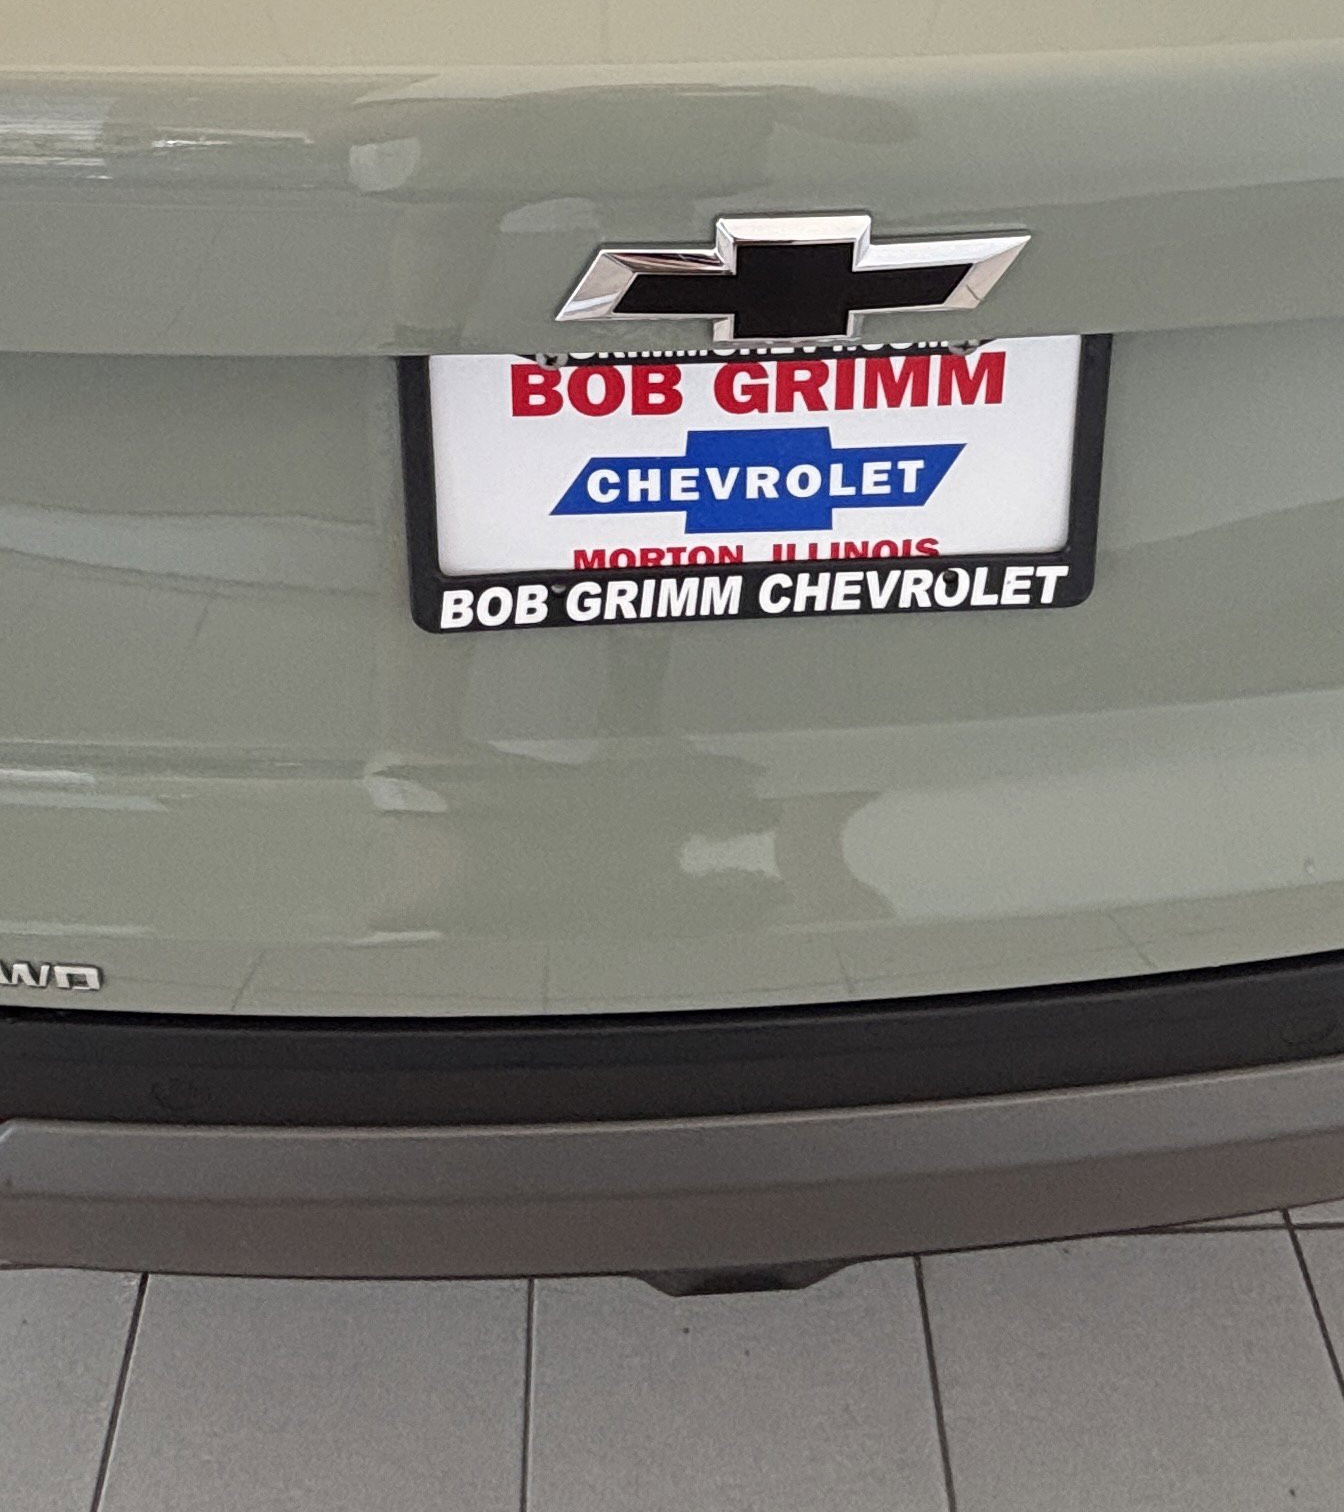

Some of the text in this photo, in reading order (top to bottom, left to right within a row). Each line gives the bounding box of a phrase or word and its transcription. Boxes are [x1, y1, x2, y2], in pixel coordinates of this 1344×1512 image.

[511, 351, 1006, 417] BOB GRIMM
[587, 459, 925, 503] CHEVROLET
[573, 544, 744, 571] MORTON
[440, 565, 1069, 629] BOB GRIMM CHEVROLET
